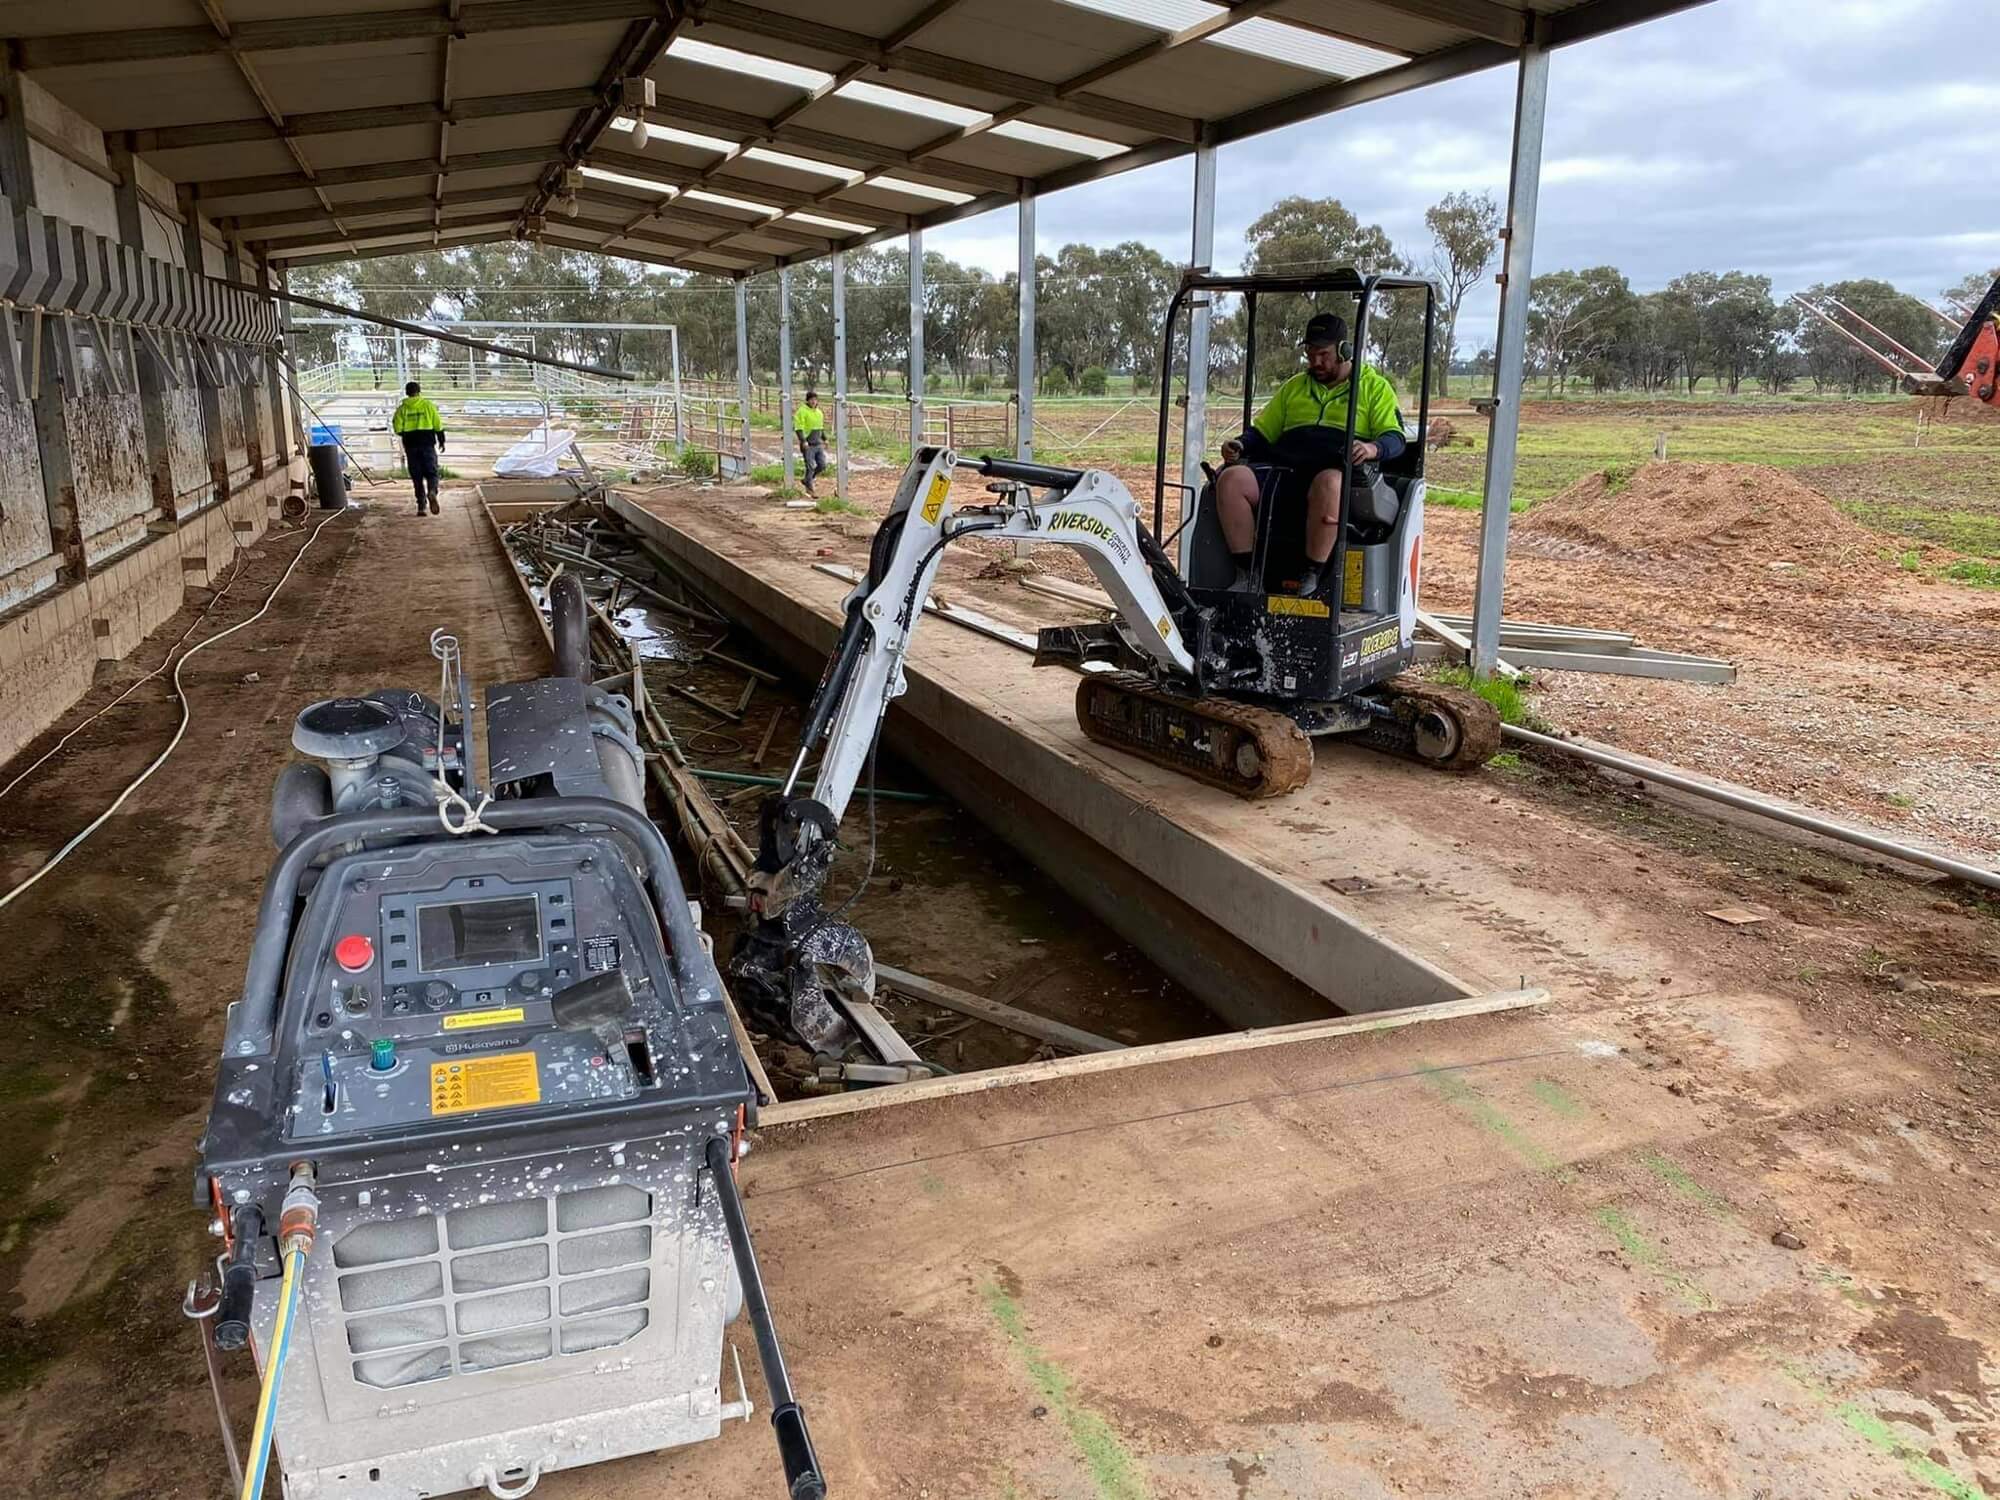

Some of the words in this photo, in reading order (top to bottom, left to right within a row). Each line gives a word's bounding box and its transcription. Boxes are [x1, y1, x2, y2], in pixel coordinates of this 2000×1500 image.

[1047, 512, 1113, 540] RIVERSIDE
[1107, 538, 1128, 565] CUTTING
[458, 1038, 520, 1051] Husqvarna
